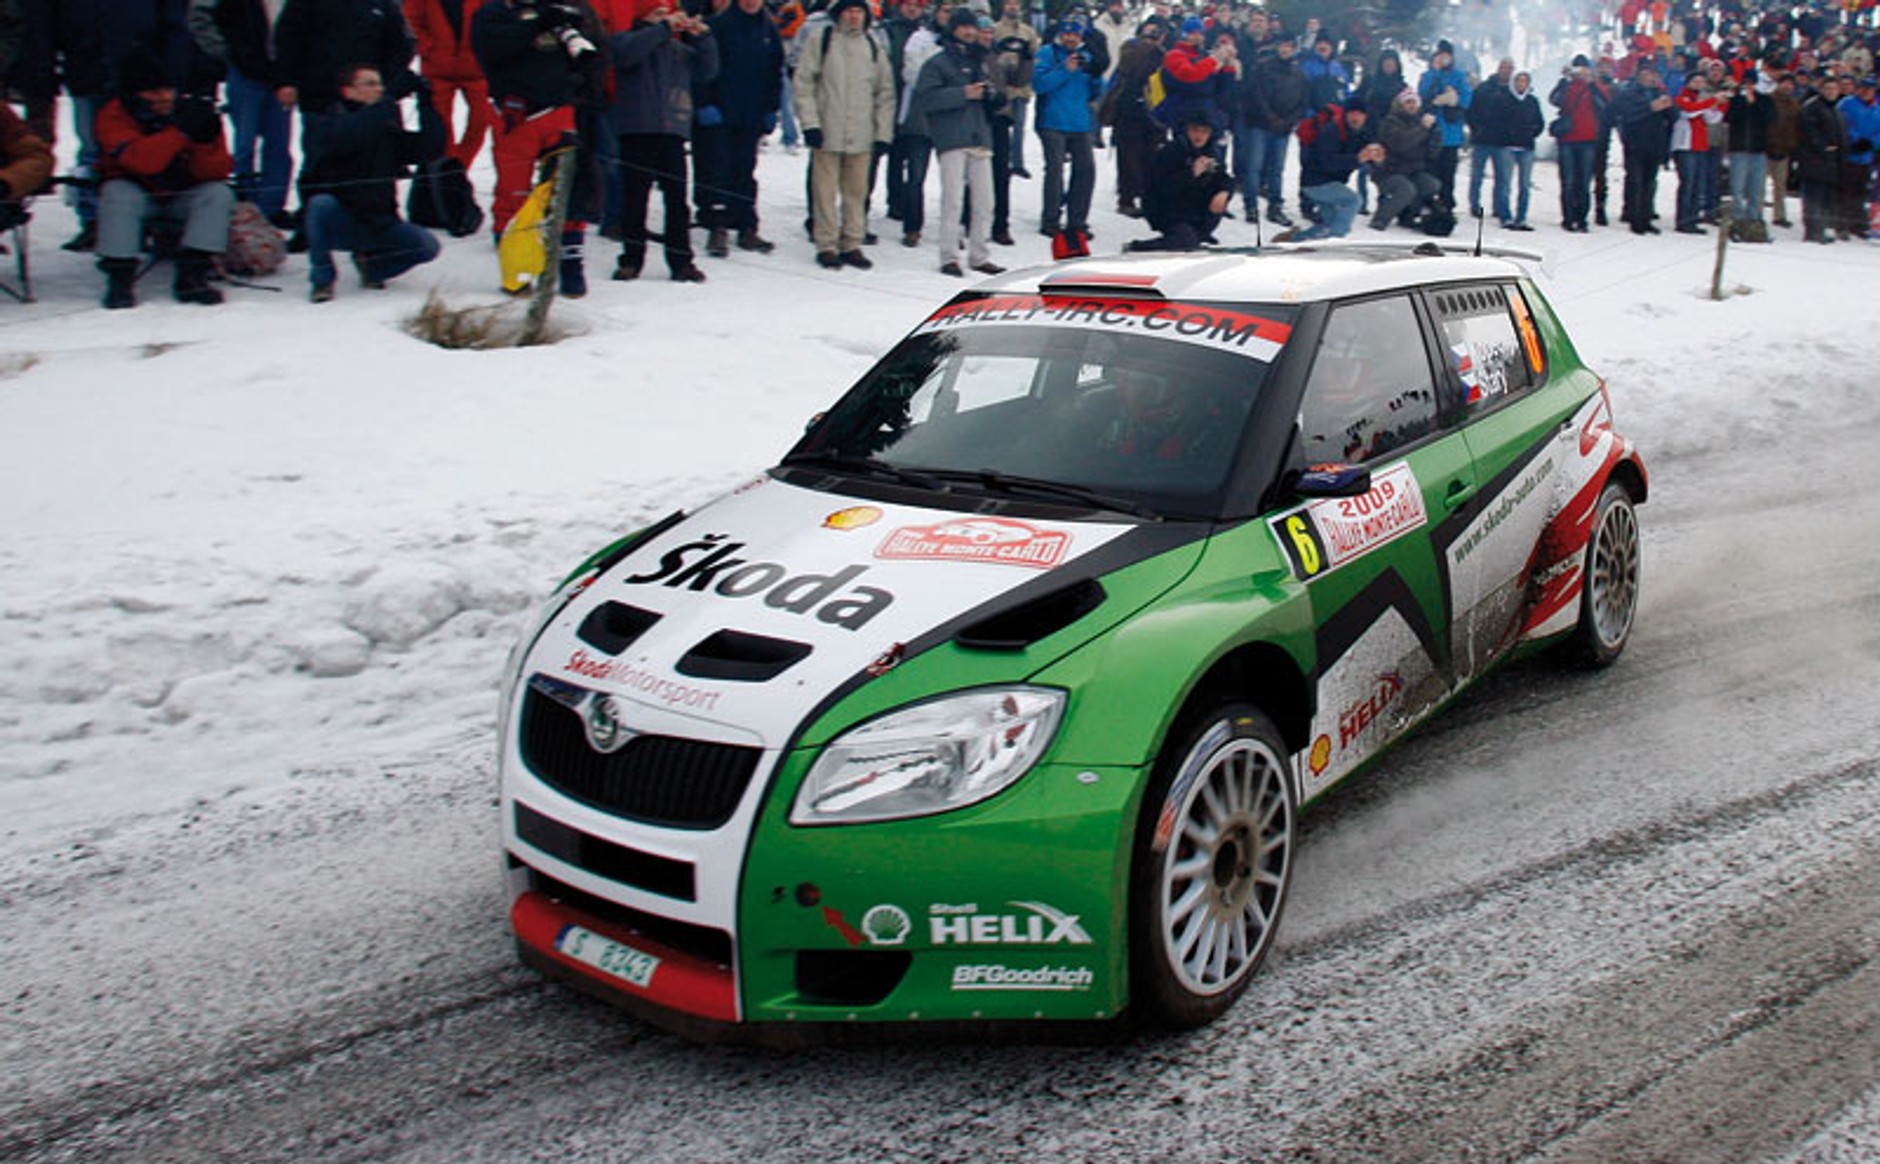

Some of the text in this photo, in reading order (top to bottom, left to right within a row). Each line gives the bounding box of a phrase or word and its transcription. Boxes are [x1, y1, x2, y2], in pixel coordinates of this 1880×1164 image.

[931, 302, 1258, 347] RALLY-IRC.COM
[1338, 481, 1394, 517] 2009
[1286, 515, 1320, 575] 6
[624, 534, 894, 631] Škoda
[1339, 669, 1403, 750] HELIX
[570, 931, 590, 956] S
[929, 901, 1093, 944] HELIX
[952, 964, 1093, 984] BFGoodrich
